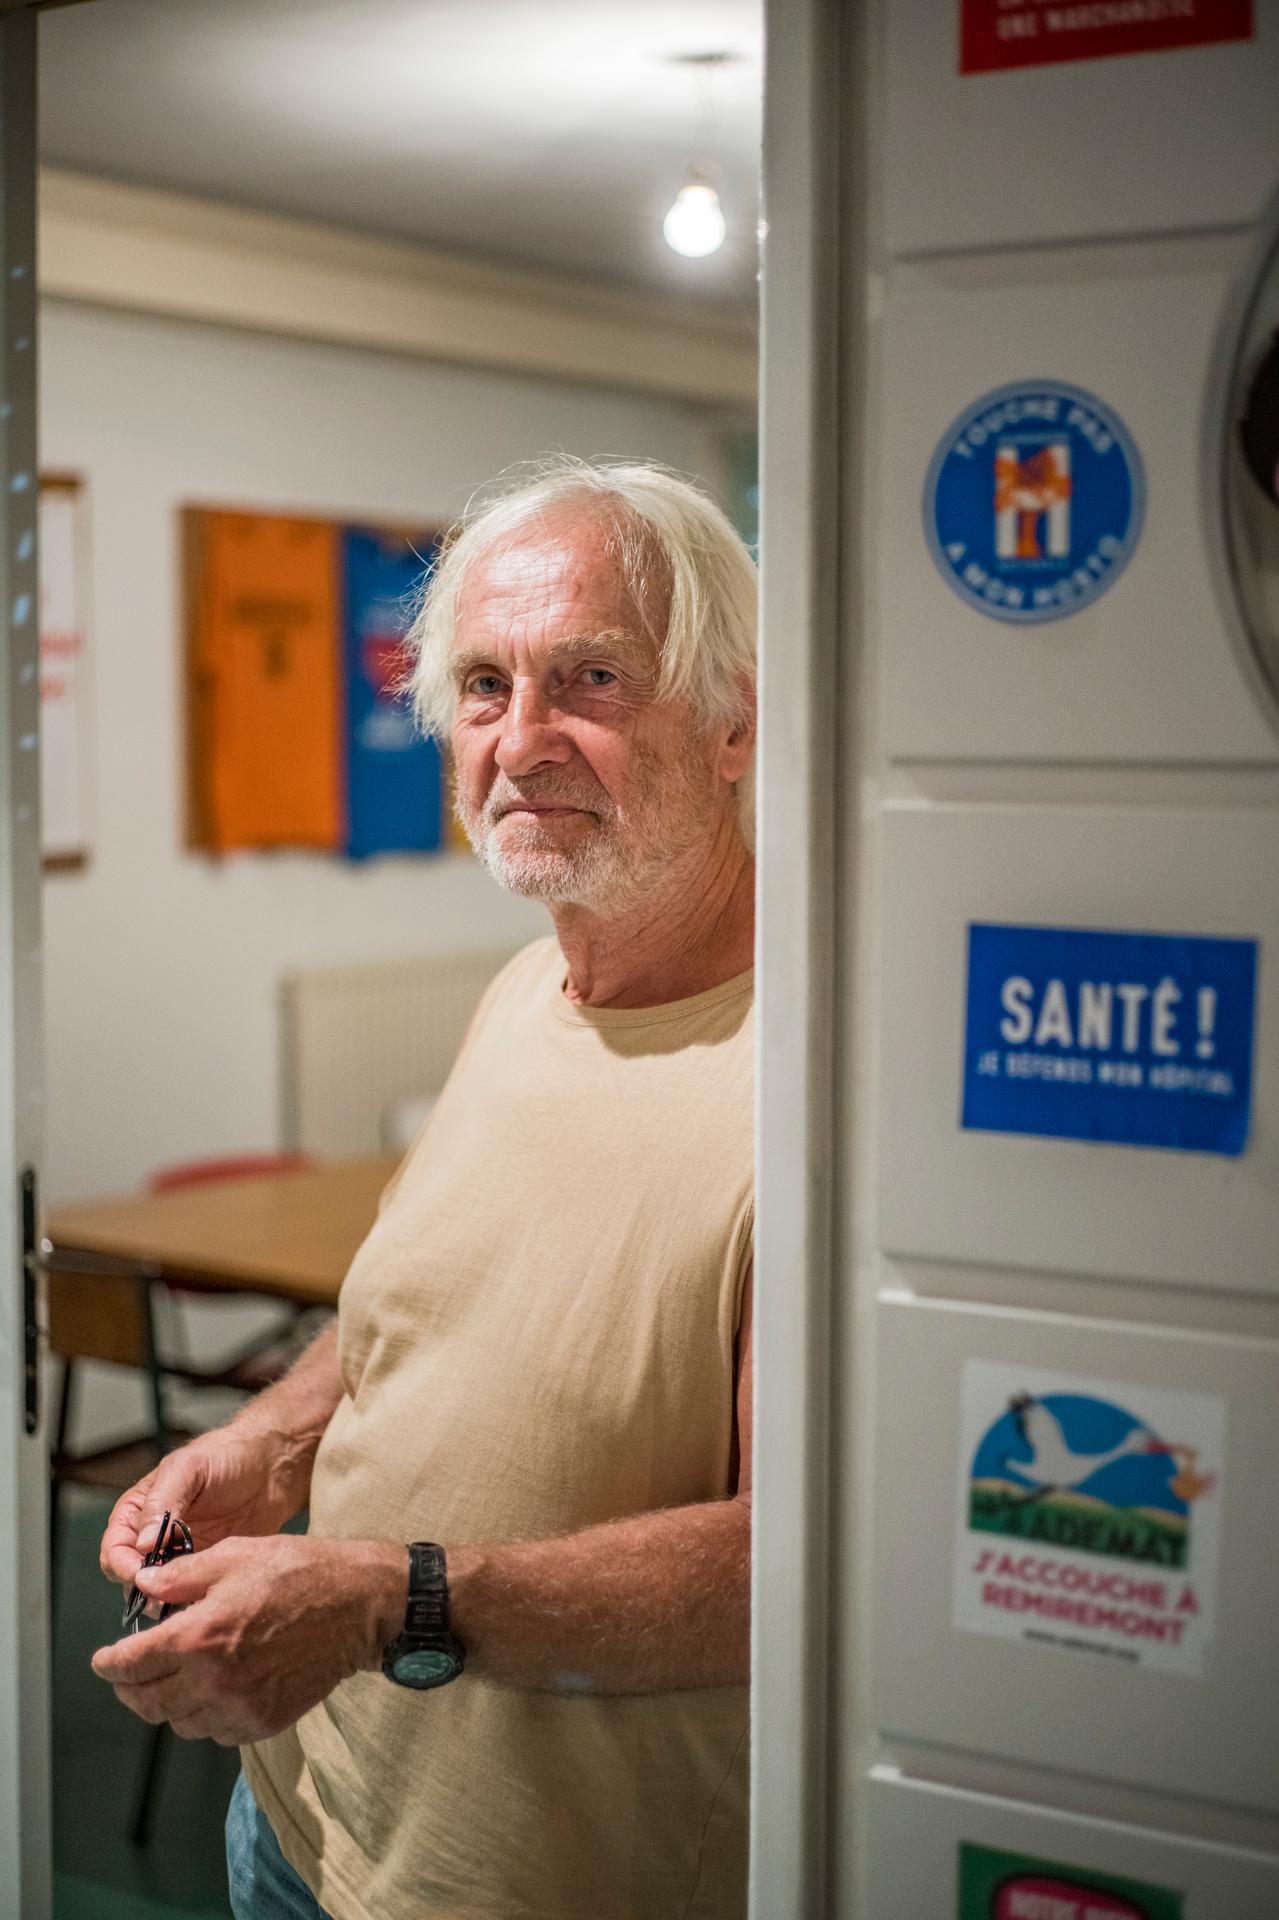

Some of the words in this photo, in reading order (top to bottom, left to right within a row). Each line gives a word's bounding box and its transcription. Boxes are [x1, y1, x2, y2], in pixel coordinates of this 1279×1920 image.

[956, 399, 1058, 458] TOUCHE
[1196, 986, 1217, 1059] !
[983, 1583, 1185, 1645] REMIREMONT
